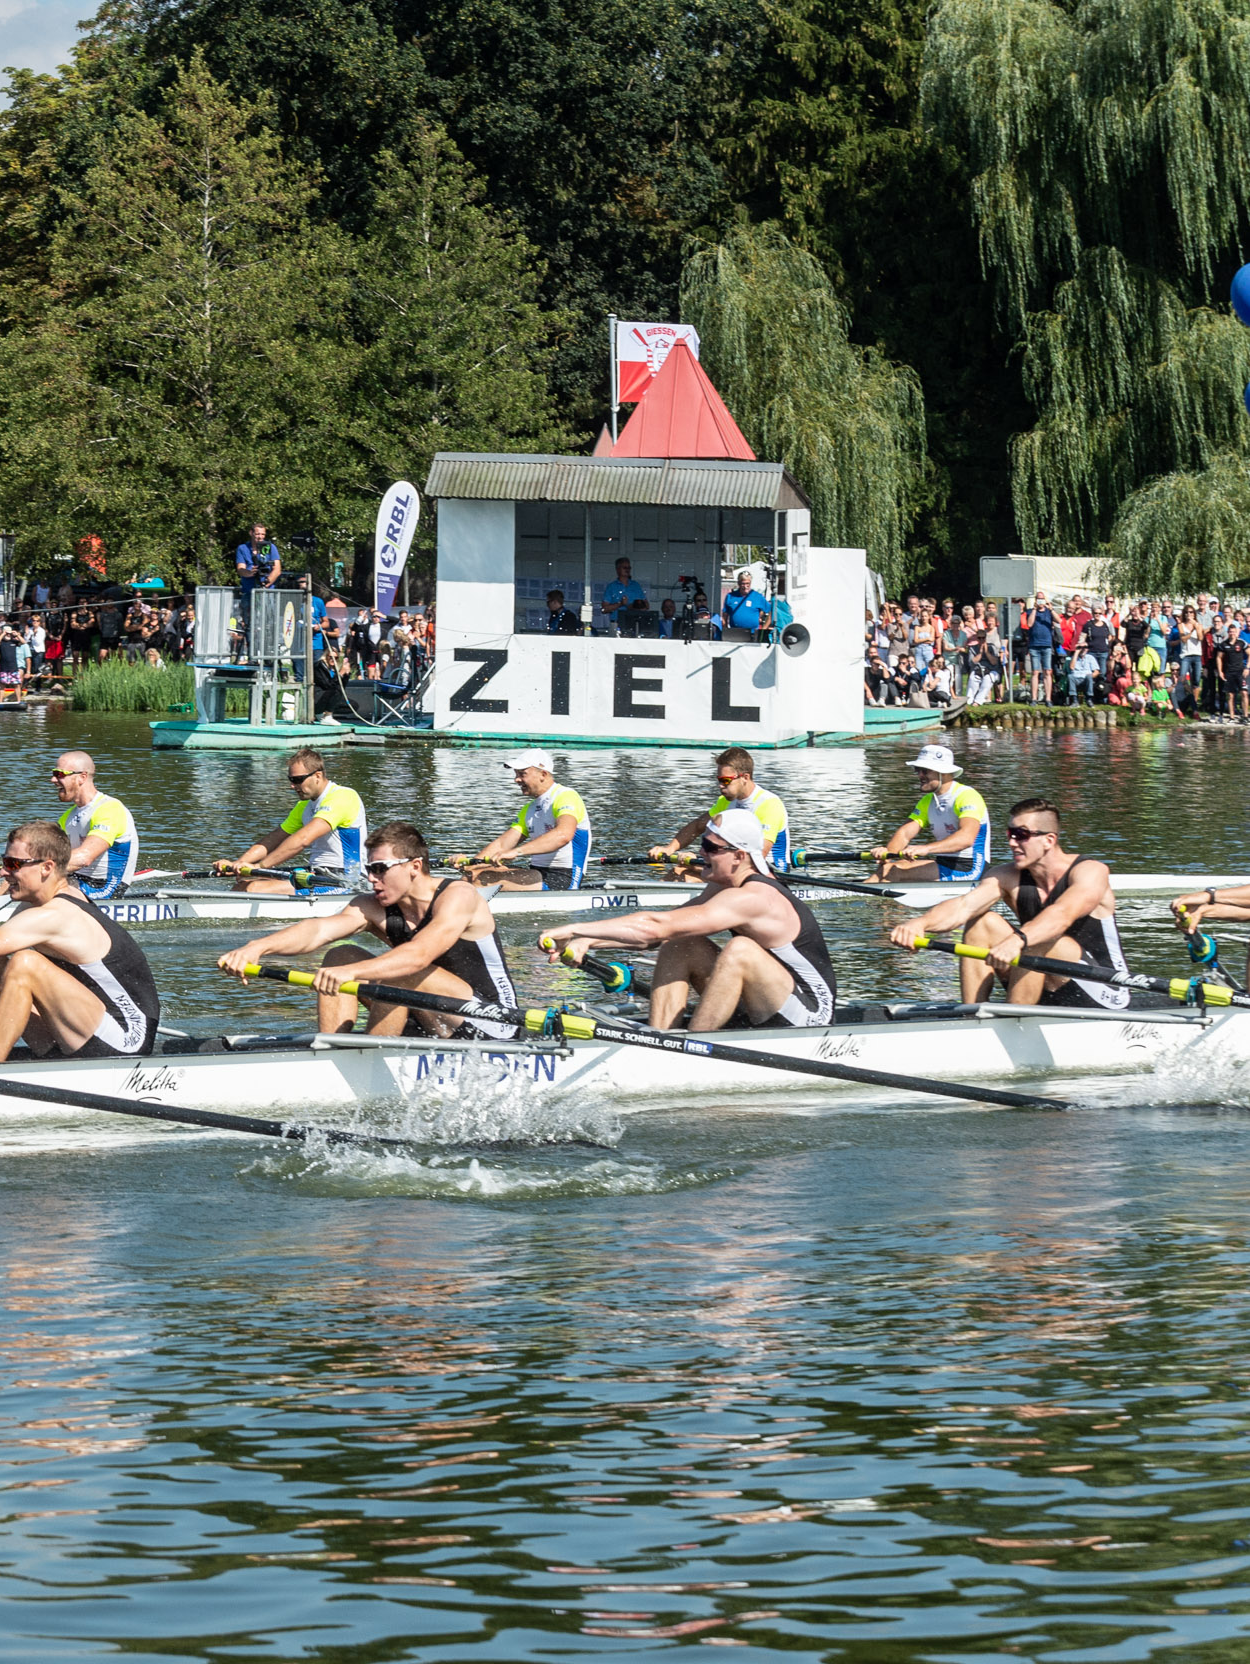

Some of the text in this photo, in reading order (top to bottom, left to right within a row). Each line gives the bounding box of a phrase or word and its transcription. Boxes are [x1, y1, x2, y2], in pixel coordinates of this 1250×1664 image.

[645, 326, 678, 337] GIESSEN
[385, 494, 410, 544] RBL
[449, 647, 760, 722] ZIEL
[596, 1027, 710, 1054] STARK. SCHNELL. GUT. RBL
[117, 1061, 179, 1094] Melitta
